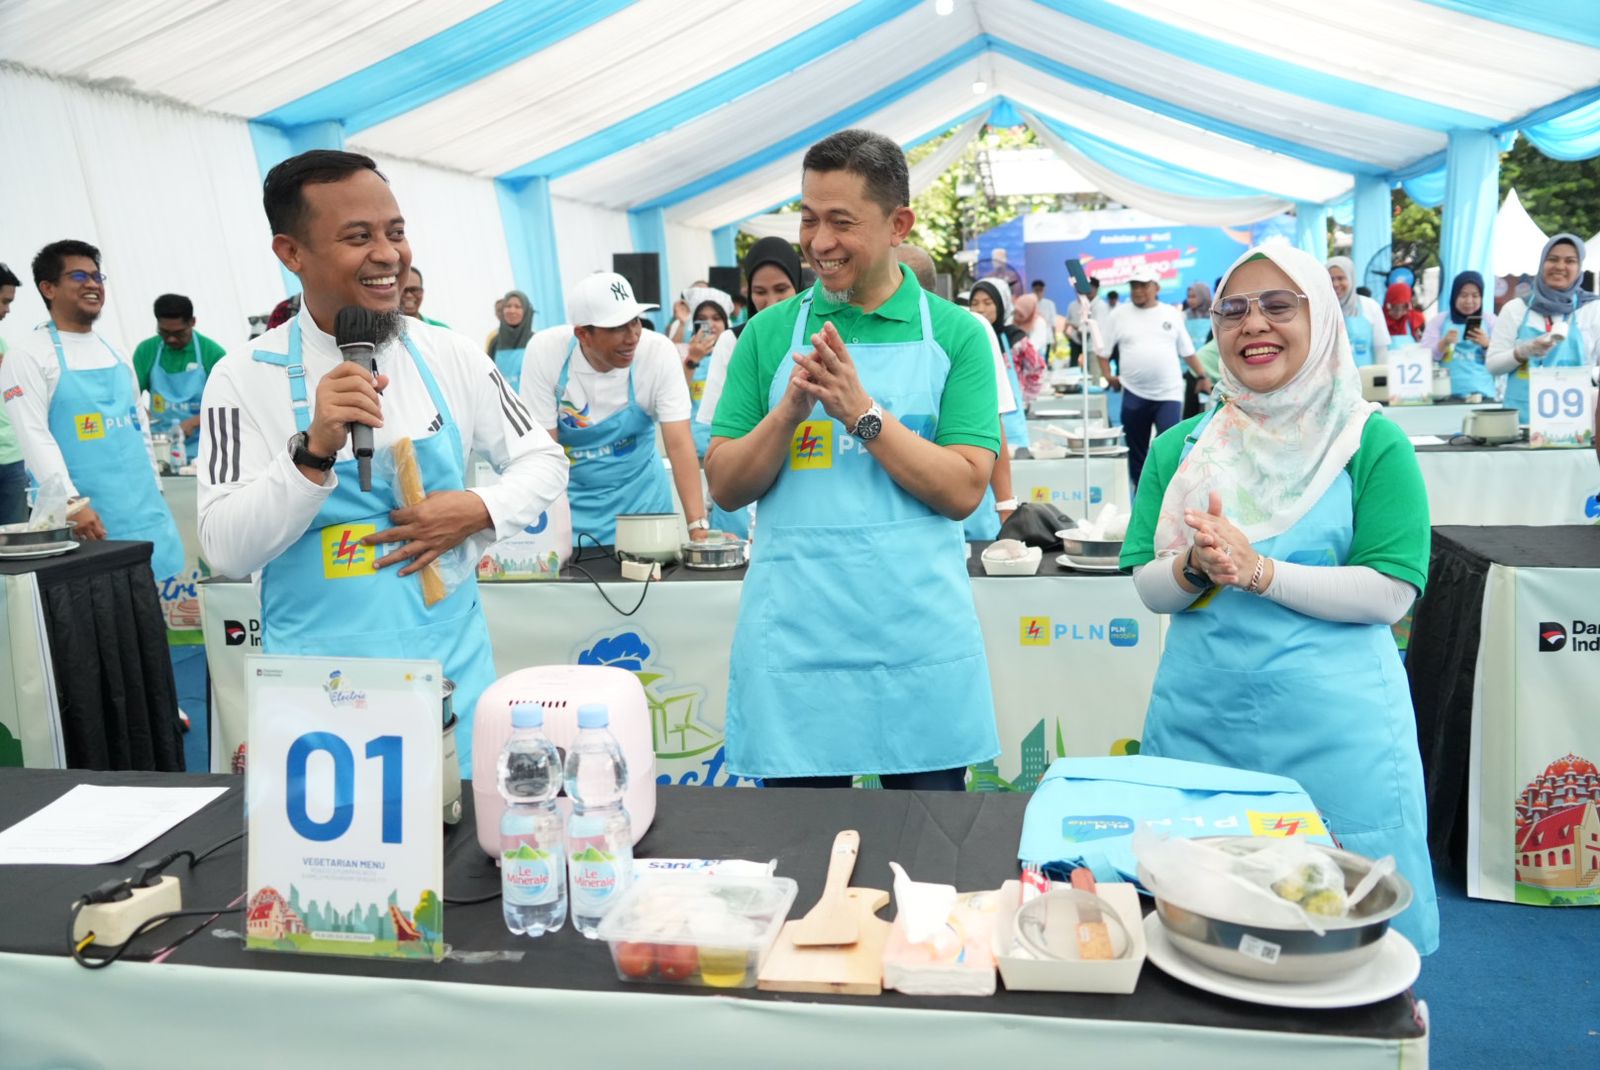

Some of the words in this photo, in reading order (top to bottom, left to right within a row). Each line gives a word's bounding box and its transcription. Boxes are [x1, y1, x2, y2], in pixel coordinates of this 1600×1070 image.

[1396, 363, 1424, 385] 12
[1537, 387, 1585, 419] 09
[838, 434, 869, 456] PL
[1051, 490, 1083, 501] PLN
[1054, 623, 1105, 641] PLN
[286, 731, 403, 844] 01
[302, 857, 359, 869] VEGETARIAN
[359, 860, 386, 870] MENU
[519, 866, 532, 877] Le
[585, 868, 598, 879] Le
[506, 873, 550, 886] Minerale
[574, 875, 616, 888] Minerale
